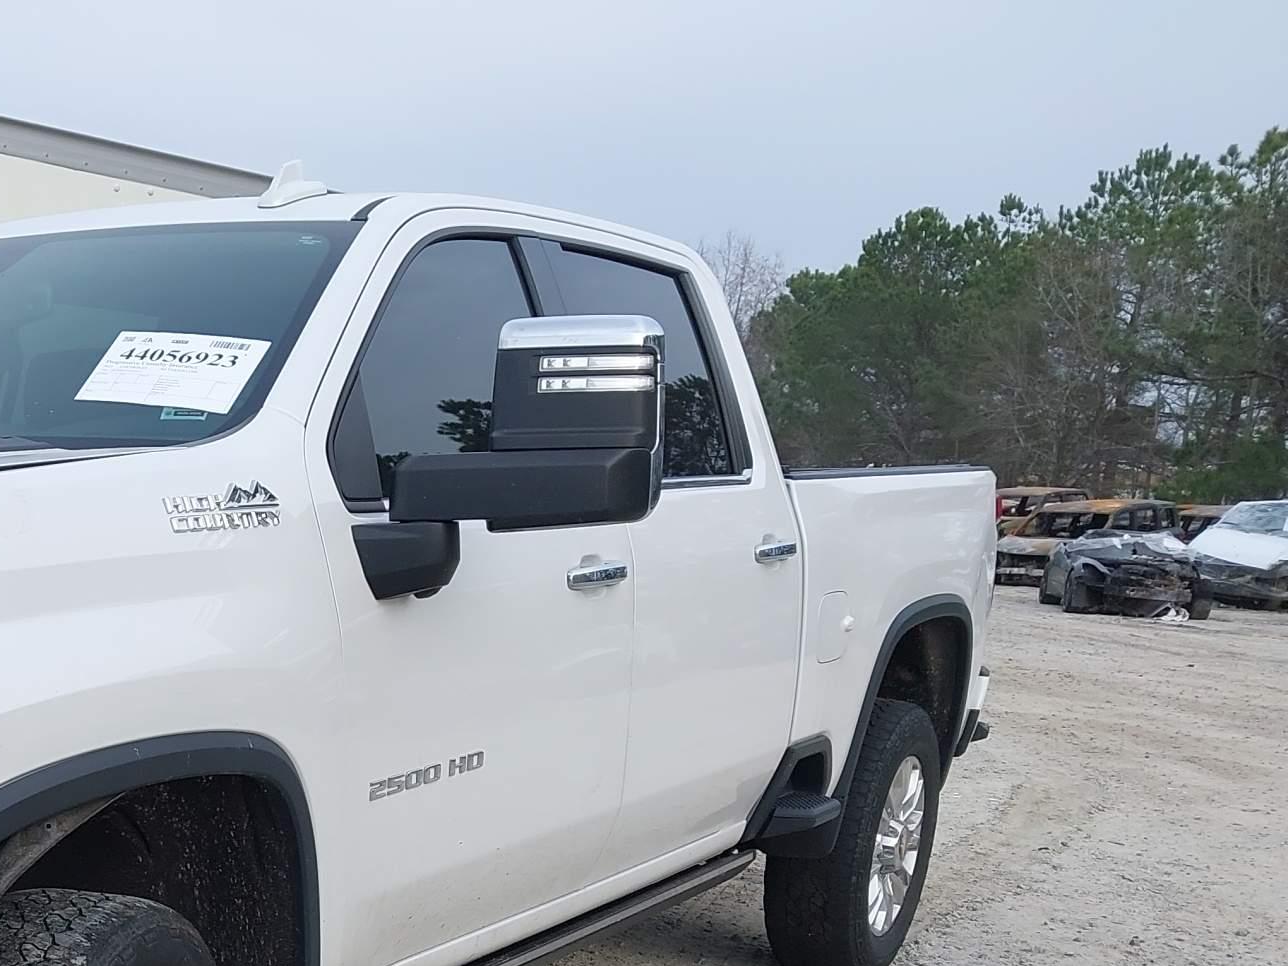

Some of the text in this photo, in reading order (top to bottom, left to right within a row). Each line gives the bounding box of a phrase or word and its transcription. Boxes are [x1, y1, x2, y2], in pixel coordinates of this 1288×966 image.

[119, 347, 239, 368] 44056923
[170, 510, 280, 533] COUNTRY
[369, 751, 484, 802] 2500 HD
